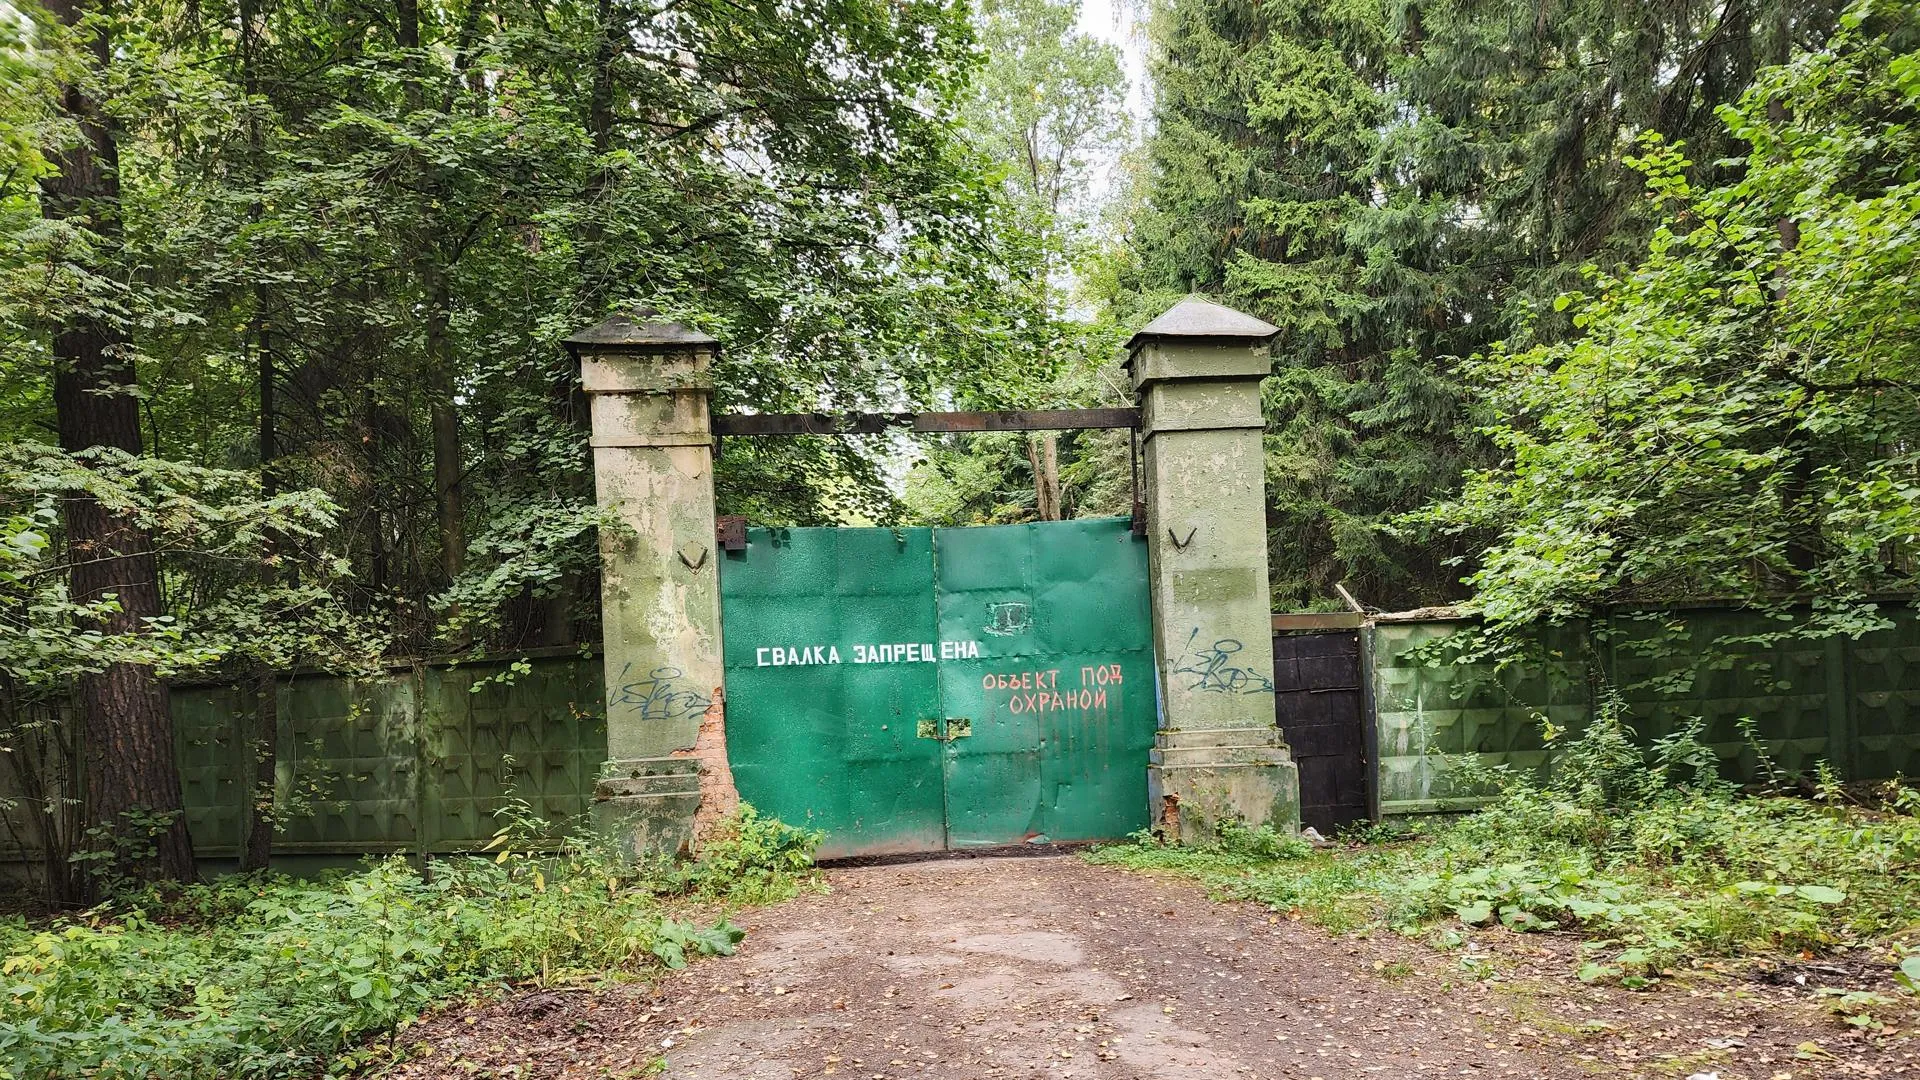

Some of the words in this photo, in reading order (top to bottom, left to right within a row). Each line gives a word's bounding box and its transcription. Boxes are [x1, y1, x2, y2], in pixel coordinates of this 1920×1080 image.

[756, 646, 841, 667] СВАЛКА
[982, 669, 1061, 690] ОБЪЕКТ
[1081, 664, 1123, 686] ПОД
[1009, 686, 1107, 714] ОХРАНОЙ
